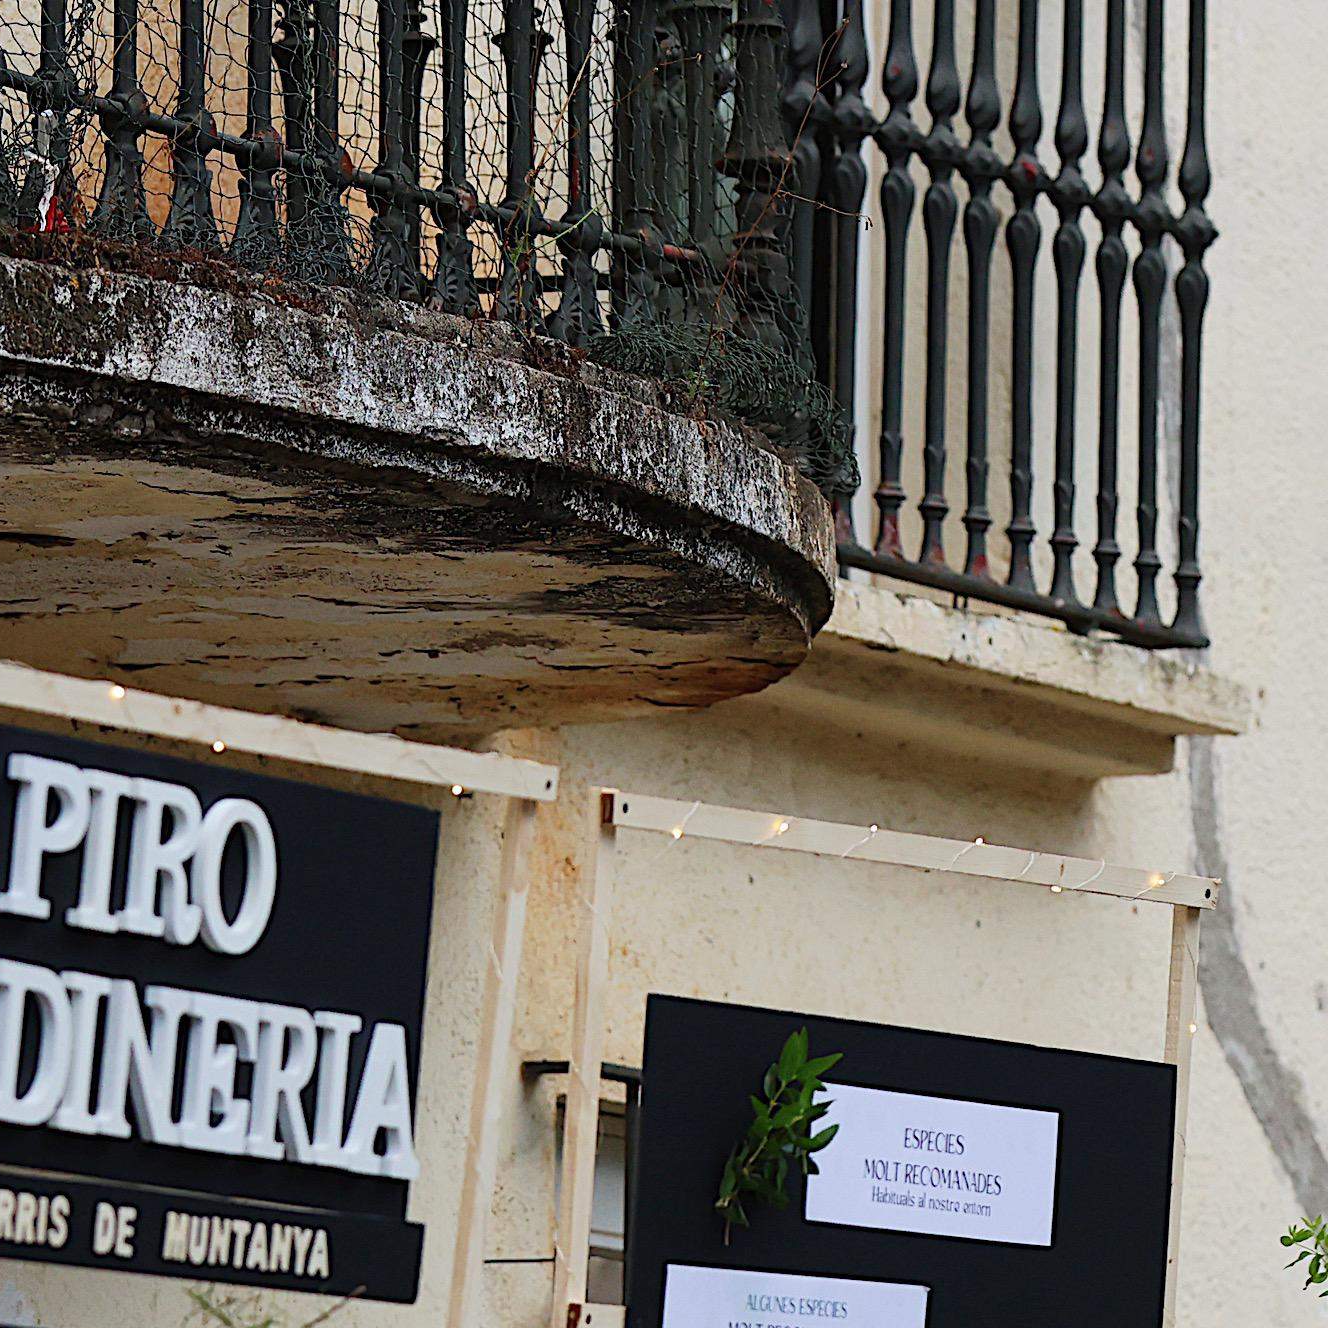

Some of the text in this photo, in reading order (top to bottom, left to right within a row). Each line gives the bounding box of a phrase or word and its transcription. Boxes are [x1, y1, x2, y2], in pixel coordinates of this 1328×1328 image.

[864, 1158, 1002, 1196] MOLT RECOMANADES
[872, 1185, 915, 1207] Habituals
[918, 1192, 925, 1208] al
[92, 1200, 137, 1259] DE
[162, 1211, 330, 1279] MUNTANYA
[746, 1294, 797, 1314] ALGUNES
